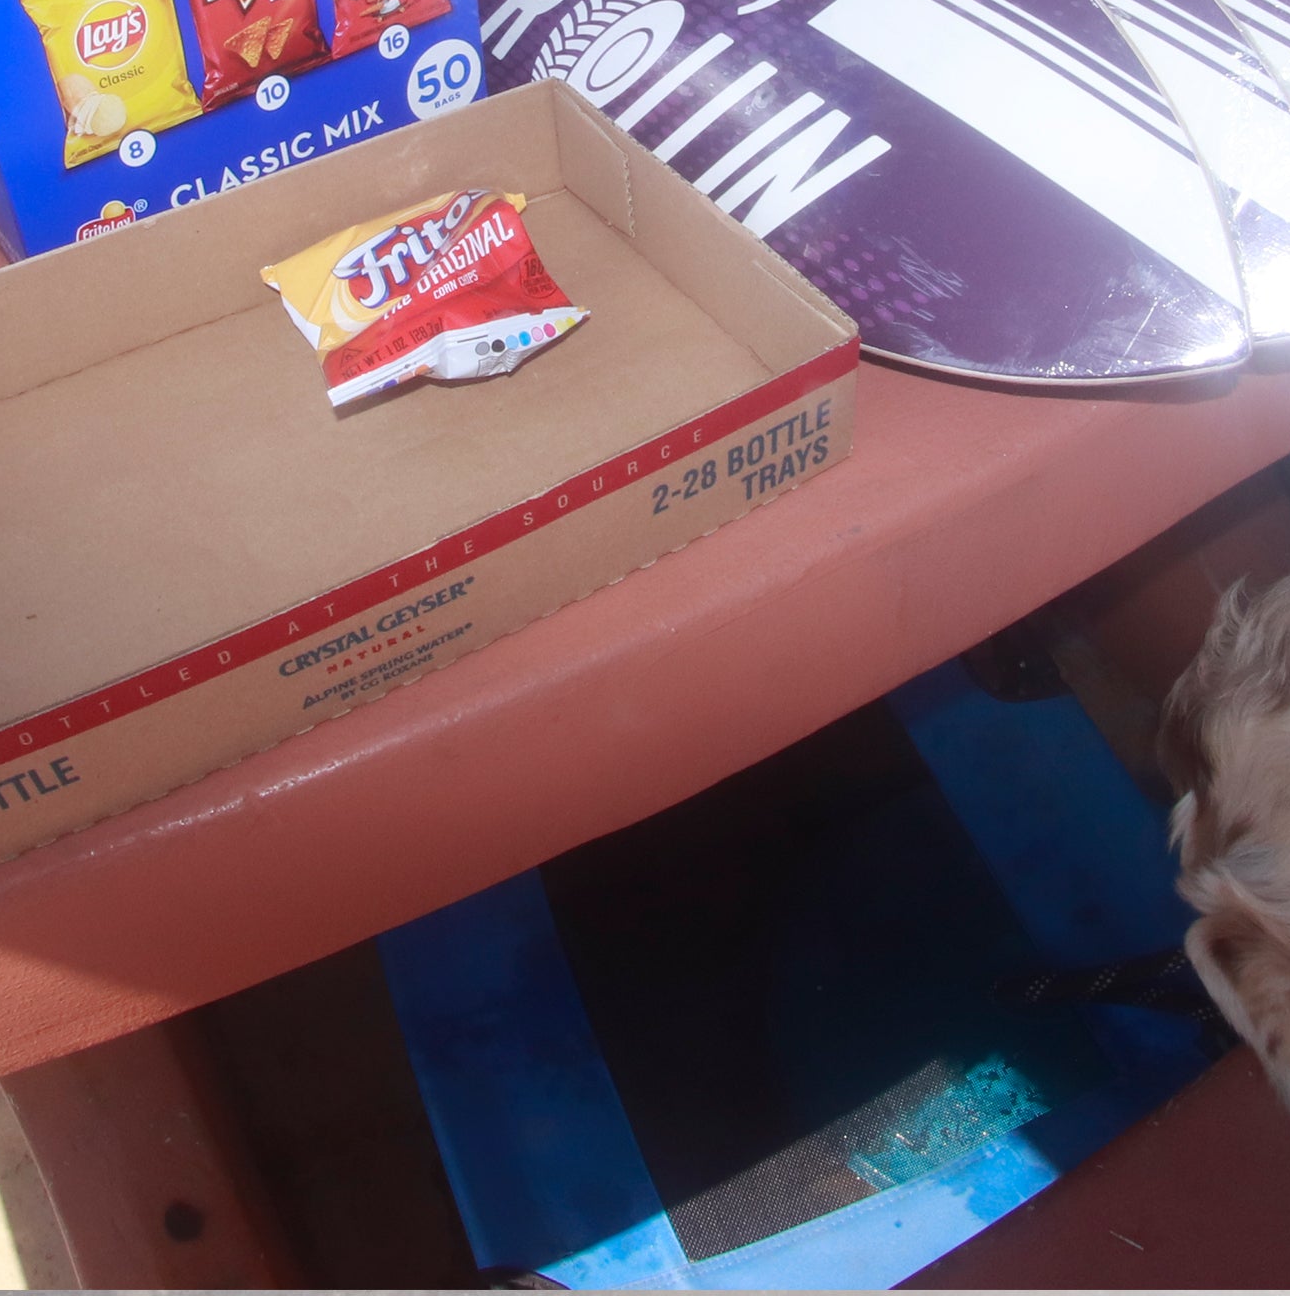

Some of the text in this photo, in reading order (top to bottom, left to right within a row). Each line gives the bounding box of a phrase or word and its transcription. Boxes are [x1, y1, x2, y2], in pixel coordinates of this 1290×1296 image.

[83, 10, 142, 58] Lay's
[384, 32, 405, 52] 16
[99, 65, 145, 89] Classic
[261, 82, 285, 104] 10
[417, 53, 471, 104] 50
[434, 92, 461, 109] BAGS
[129, 140, 144, 160] 8
[170, 100, 384, 210] CLASSIC MIX
[417, 212, 514, 294] ORIGINAL
[433, 271, 479, 301] CORN CHIPS
[651, 399, 832, 516] 2-28 BOTTLE
[741, 435, 830, 501] TRAYS
[287, 603, 334, 635] AT
[388, 538, 475, 588] THE
[523, 428, 703, 526] SOURCE
[279, 626, 374, 677] CRYSTAL
[326, 625, 426, 675] NATURAL
[302, 676, 358, 710] ALPINE
[360, 652, 414, 681] SPRING
[341, 654, 434, 701] BY CG ROXANE
